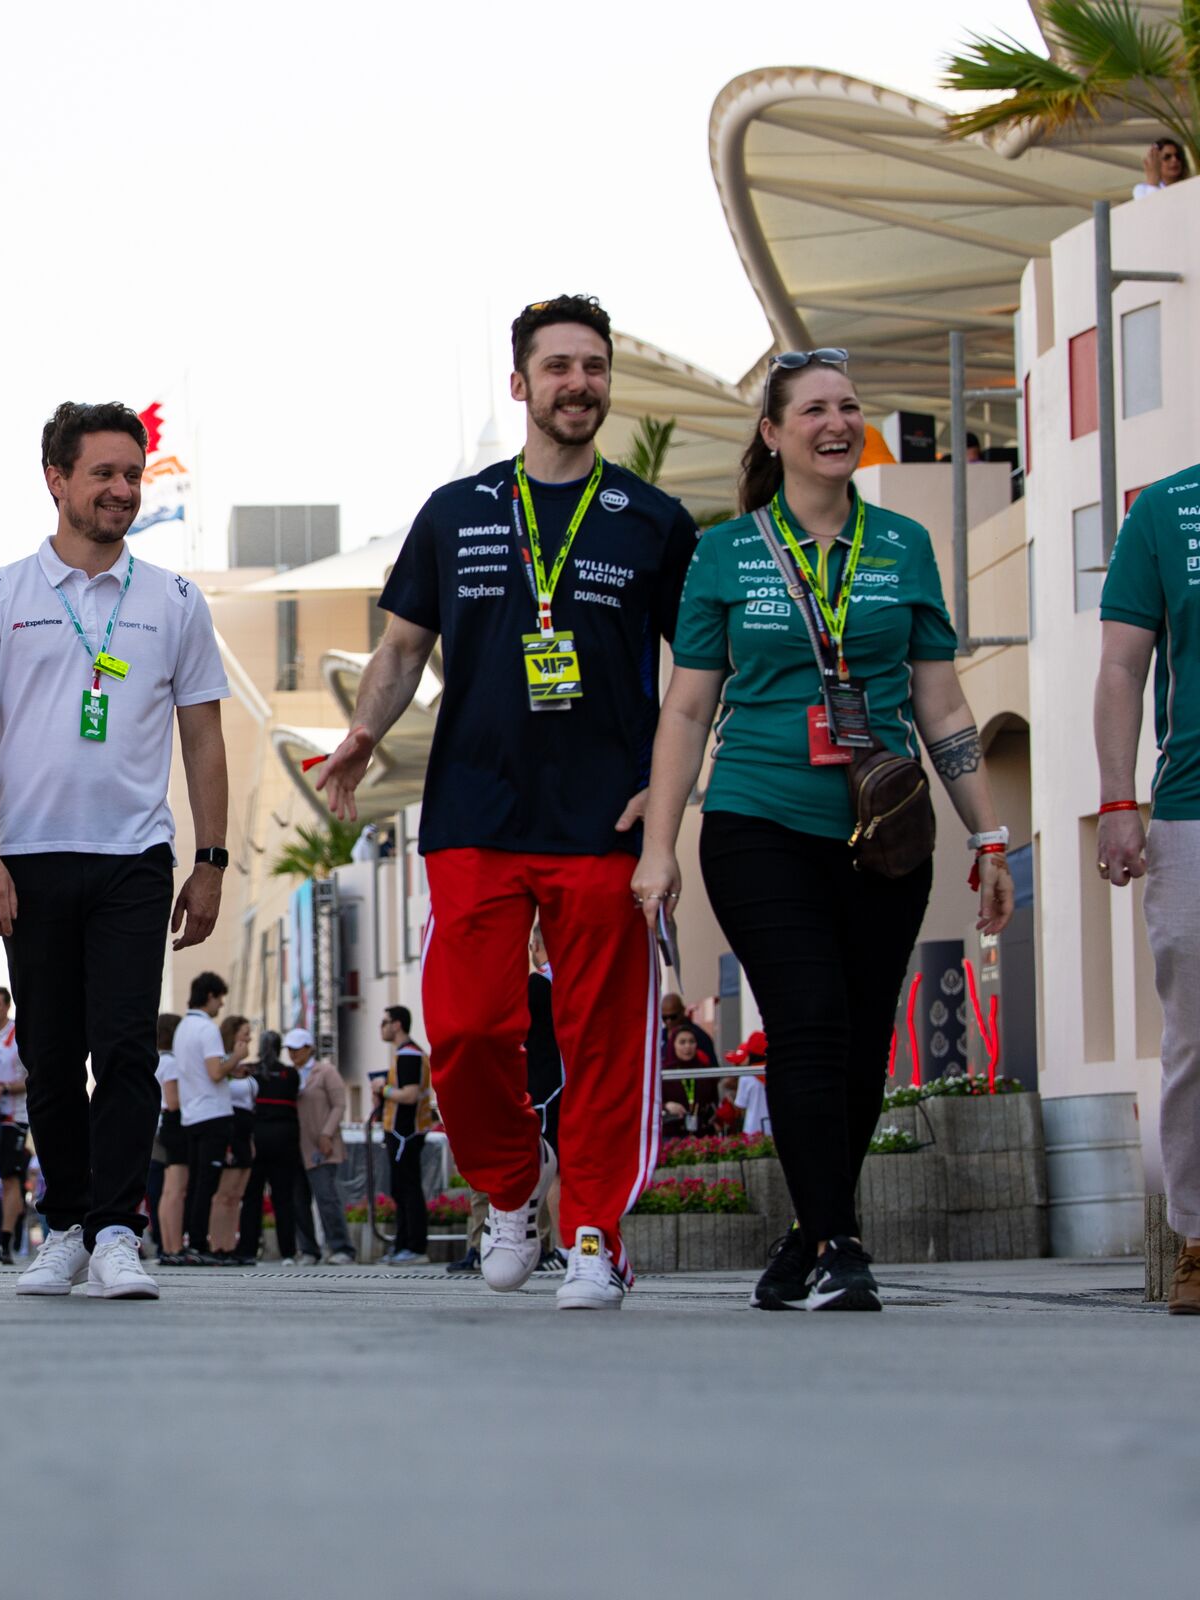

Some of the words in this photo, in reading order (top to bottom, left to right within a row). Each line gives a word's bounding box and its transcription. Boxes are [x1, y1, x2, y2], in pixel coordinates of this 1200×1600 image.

[459, 523, 510, 538] KOMATSU
[464, 565, 508, 574] MYPROTEIN
[574, 558, 634, 580] WILLIAMS
[579, 569, 625, 588] RACING
[457, 584, 505, 599] Stephens
[748, 602, 788, 614] JCB
[25, 618, 63, 628] Experiences
[118, 620, 141, 629] Expert
[142, 623, 158, 633] Host
[531, 656, 574, 674] VIP
